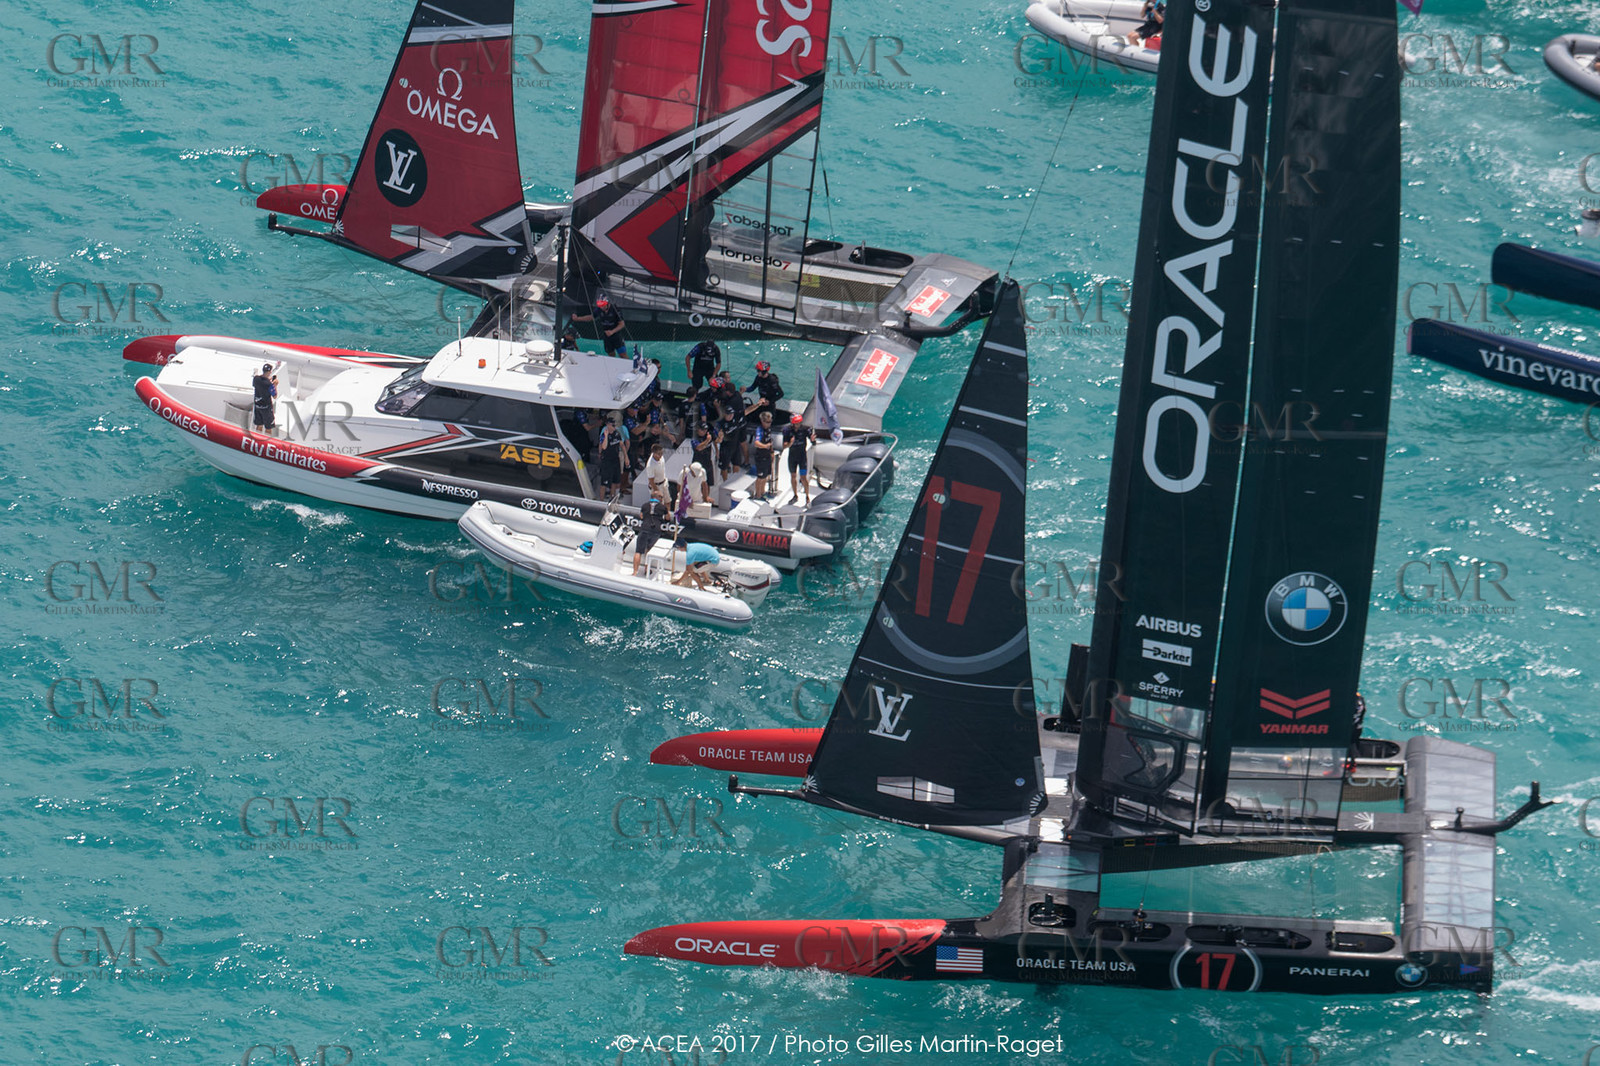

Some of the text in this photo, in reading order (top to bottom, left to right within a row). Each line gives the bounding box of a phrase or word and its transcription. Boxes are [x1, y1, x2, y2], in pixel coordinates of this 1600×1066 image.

[407, 88, 499, 140] OMEGA
[300, 202, 338, 220] OME
[718, 245, 791, 270] Torpedo7
[1142, 13, 1257, 493] ORACLE
[706, 317, 762, 332] vodafone
[162, 406, 209, 438] OMEGA
[240, 435, 265, 457] Fly
[265, 442, 327, 472] Emirates
[421, 478, 479, 500] NESPRESSO
[538, 501, 582, 518] TOYOTA
[624, 515, 685, 534] Tordo7
[741, 530, 789, 550] YAMAHA
[914, 475, 1001, 626] 17
[1135, 614, 1203, 638] AIRBUS
[1152, 646, 1191, 663] Parker
[1138, 681, 1184, 698] SPERRY
[1260, 723, 1329, 735] YANMAR
[698, 746, 813, 764] ORACLE TEAM USA
[674, 937, 777, 958] ORACLE
[1016, 957, 1136, 972] ORACLE TEAM USA
[1195, 952, 1236, 990] 17
[1289, 966, 1371, 978] PANERAI
